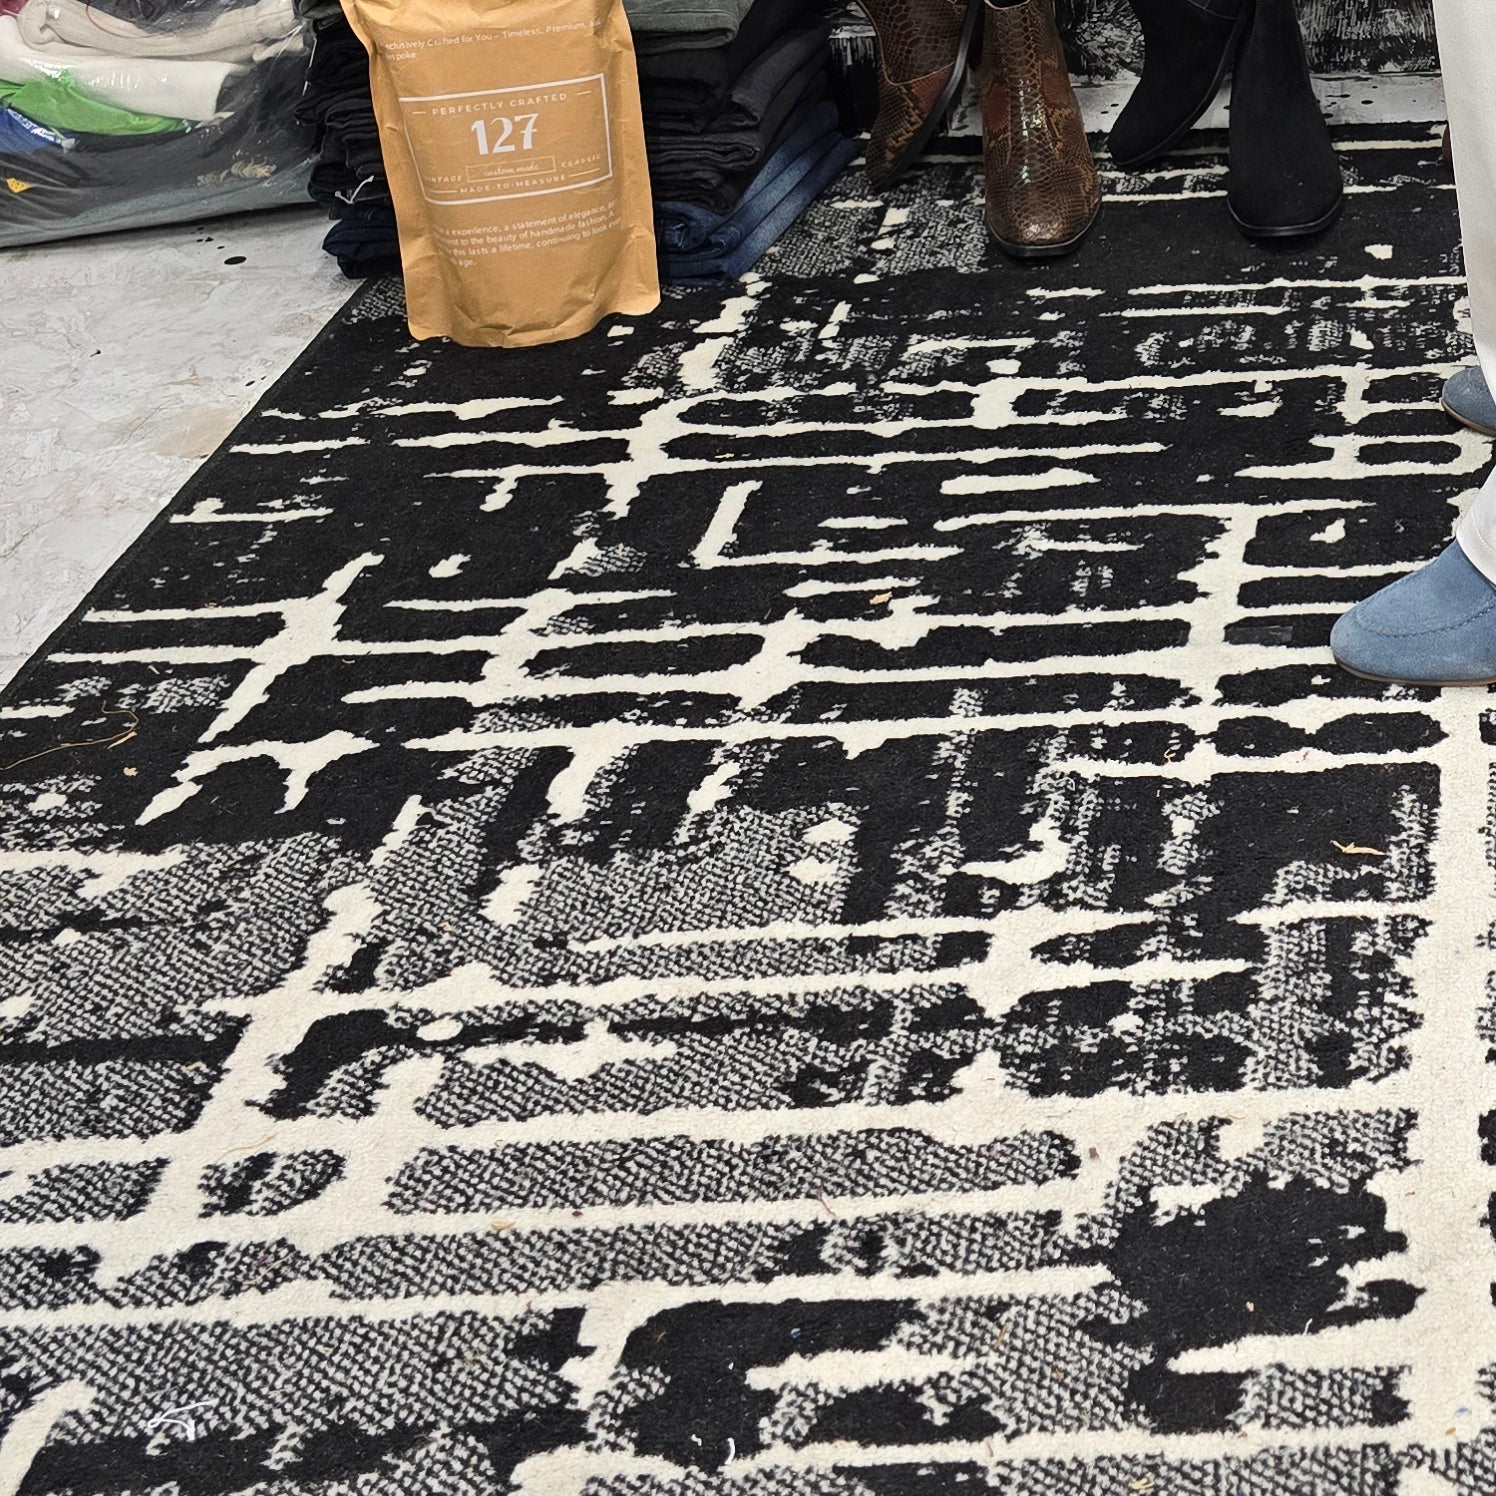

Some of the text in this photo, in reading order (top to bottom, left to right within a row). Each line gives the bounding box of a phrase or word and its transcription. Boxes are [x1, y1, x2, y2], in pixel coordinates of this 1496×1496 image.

[382, 40, 425, 50] xclusively
[461, 35, 473, 43] for
[431, 92, 567, 116] PERFECTLY CRAFTED
[470, 112, 540, 156] 127
[560, 155, 601, 169] CLASSIC
[512, 217, 557, 230] statement
[558, 213, 567, 222] of
[453, 247, 466, 256] this
[468, 246, 488, 255] lasts
[491, 246, 497, 254] a
[536, 232, 581, 248] continuing
[582, 230, 591, 238] to
[592, 223, 607, 234] look
[460, 238, 469, 246] to
[470, 237, 484, 245] the
[486, 233, 517, 244] beauty
[519, 230, 528, 239] of
[529, 223, 576, 238] handmade
